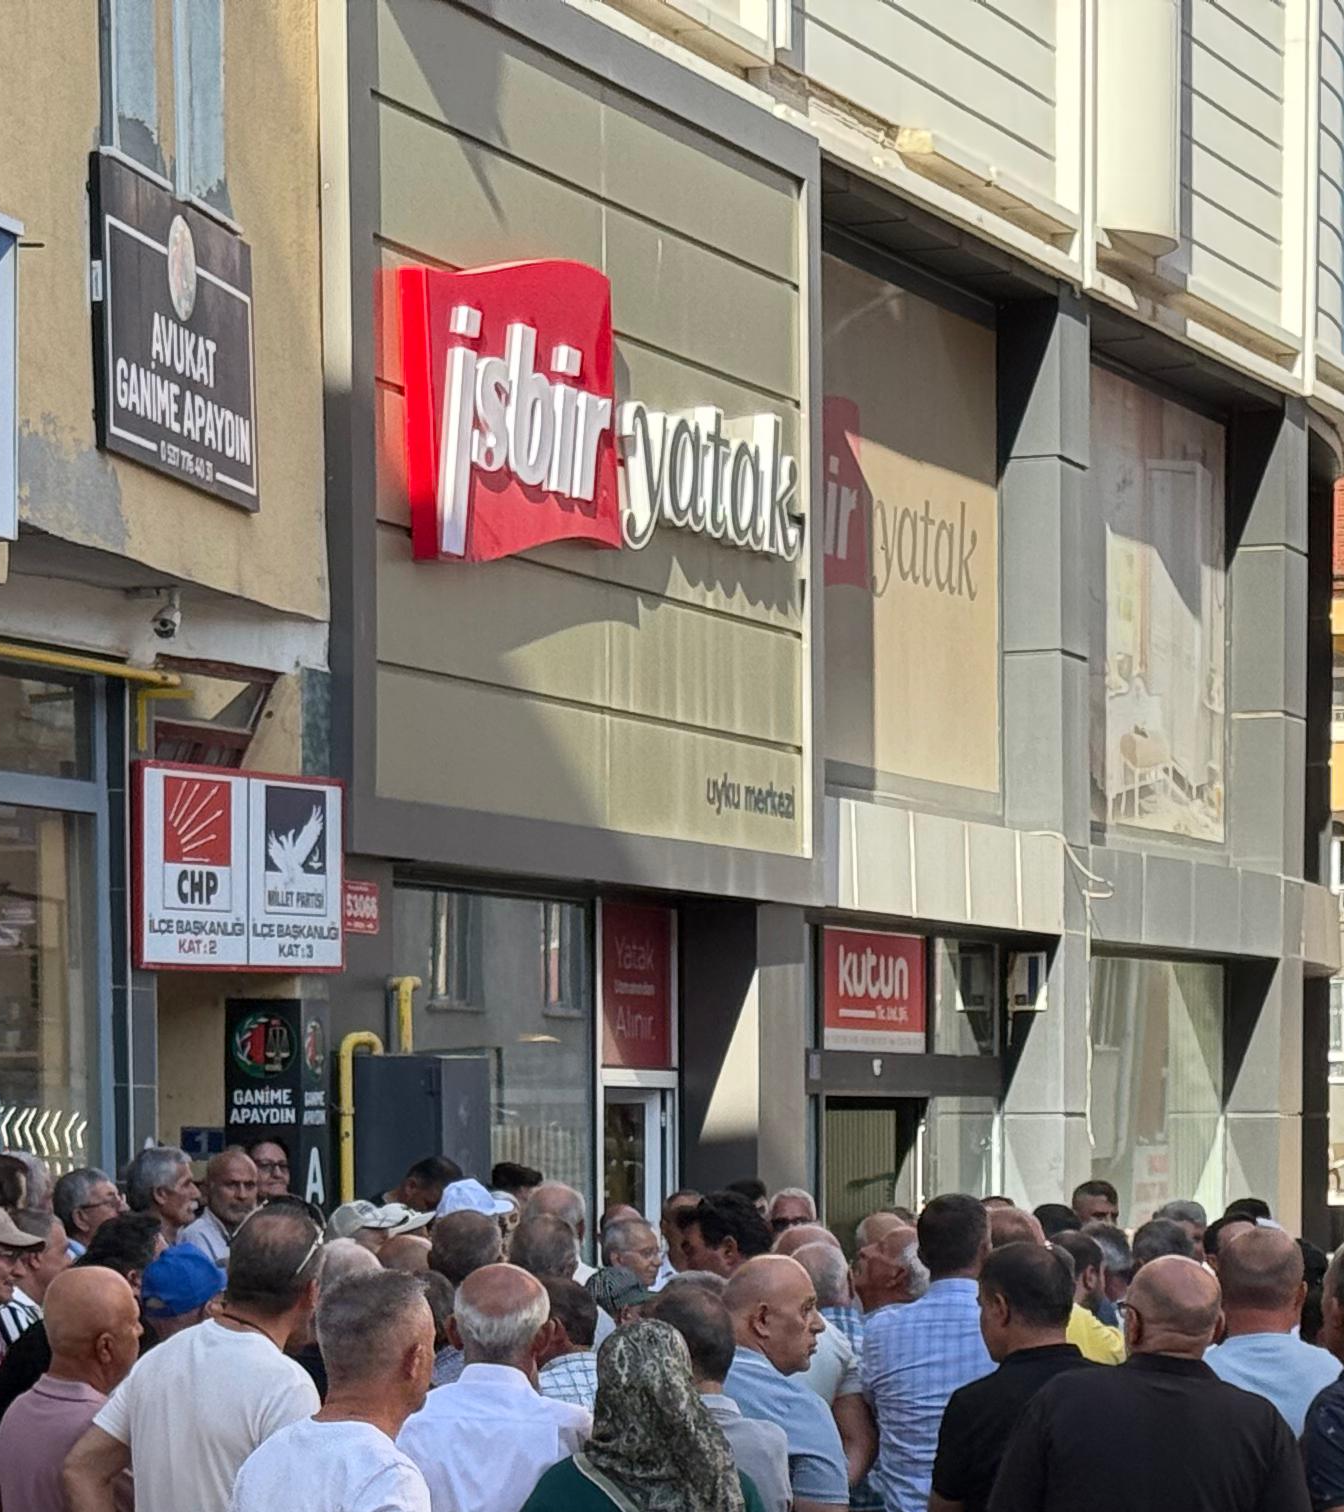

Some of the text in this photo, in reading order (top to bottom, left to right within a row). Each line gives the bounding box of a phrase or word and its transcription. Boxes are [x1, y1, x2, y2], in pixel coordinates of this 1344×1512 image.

[152, 312, 216, 388] AVUKAT
[116, 357, 251, 466] GANİME APAYDIN
[618, 400, 802, 563] yatak
[872, 499, 978, 602] yatak
[706, 772, 796, 822] uyku merkezi
[177, 869, 219, 906] CHP
[176, 917, 246, 937] BAŞKANLIĞI
[276, 920, 340, 942] BAŞKANLIĞI
[614, 935, 655, 970] Yatak
[838, 943, 909, 1001] kutun
[229, 1107, 297, 1125] APAYDIN
[233, 1085, 292, 1106] GANİME
